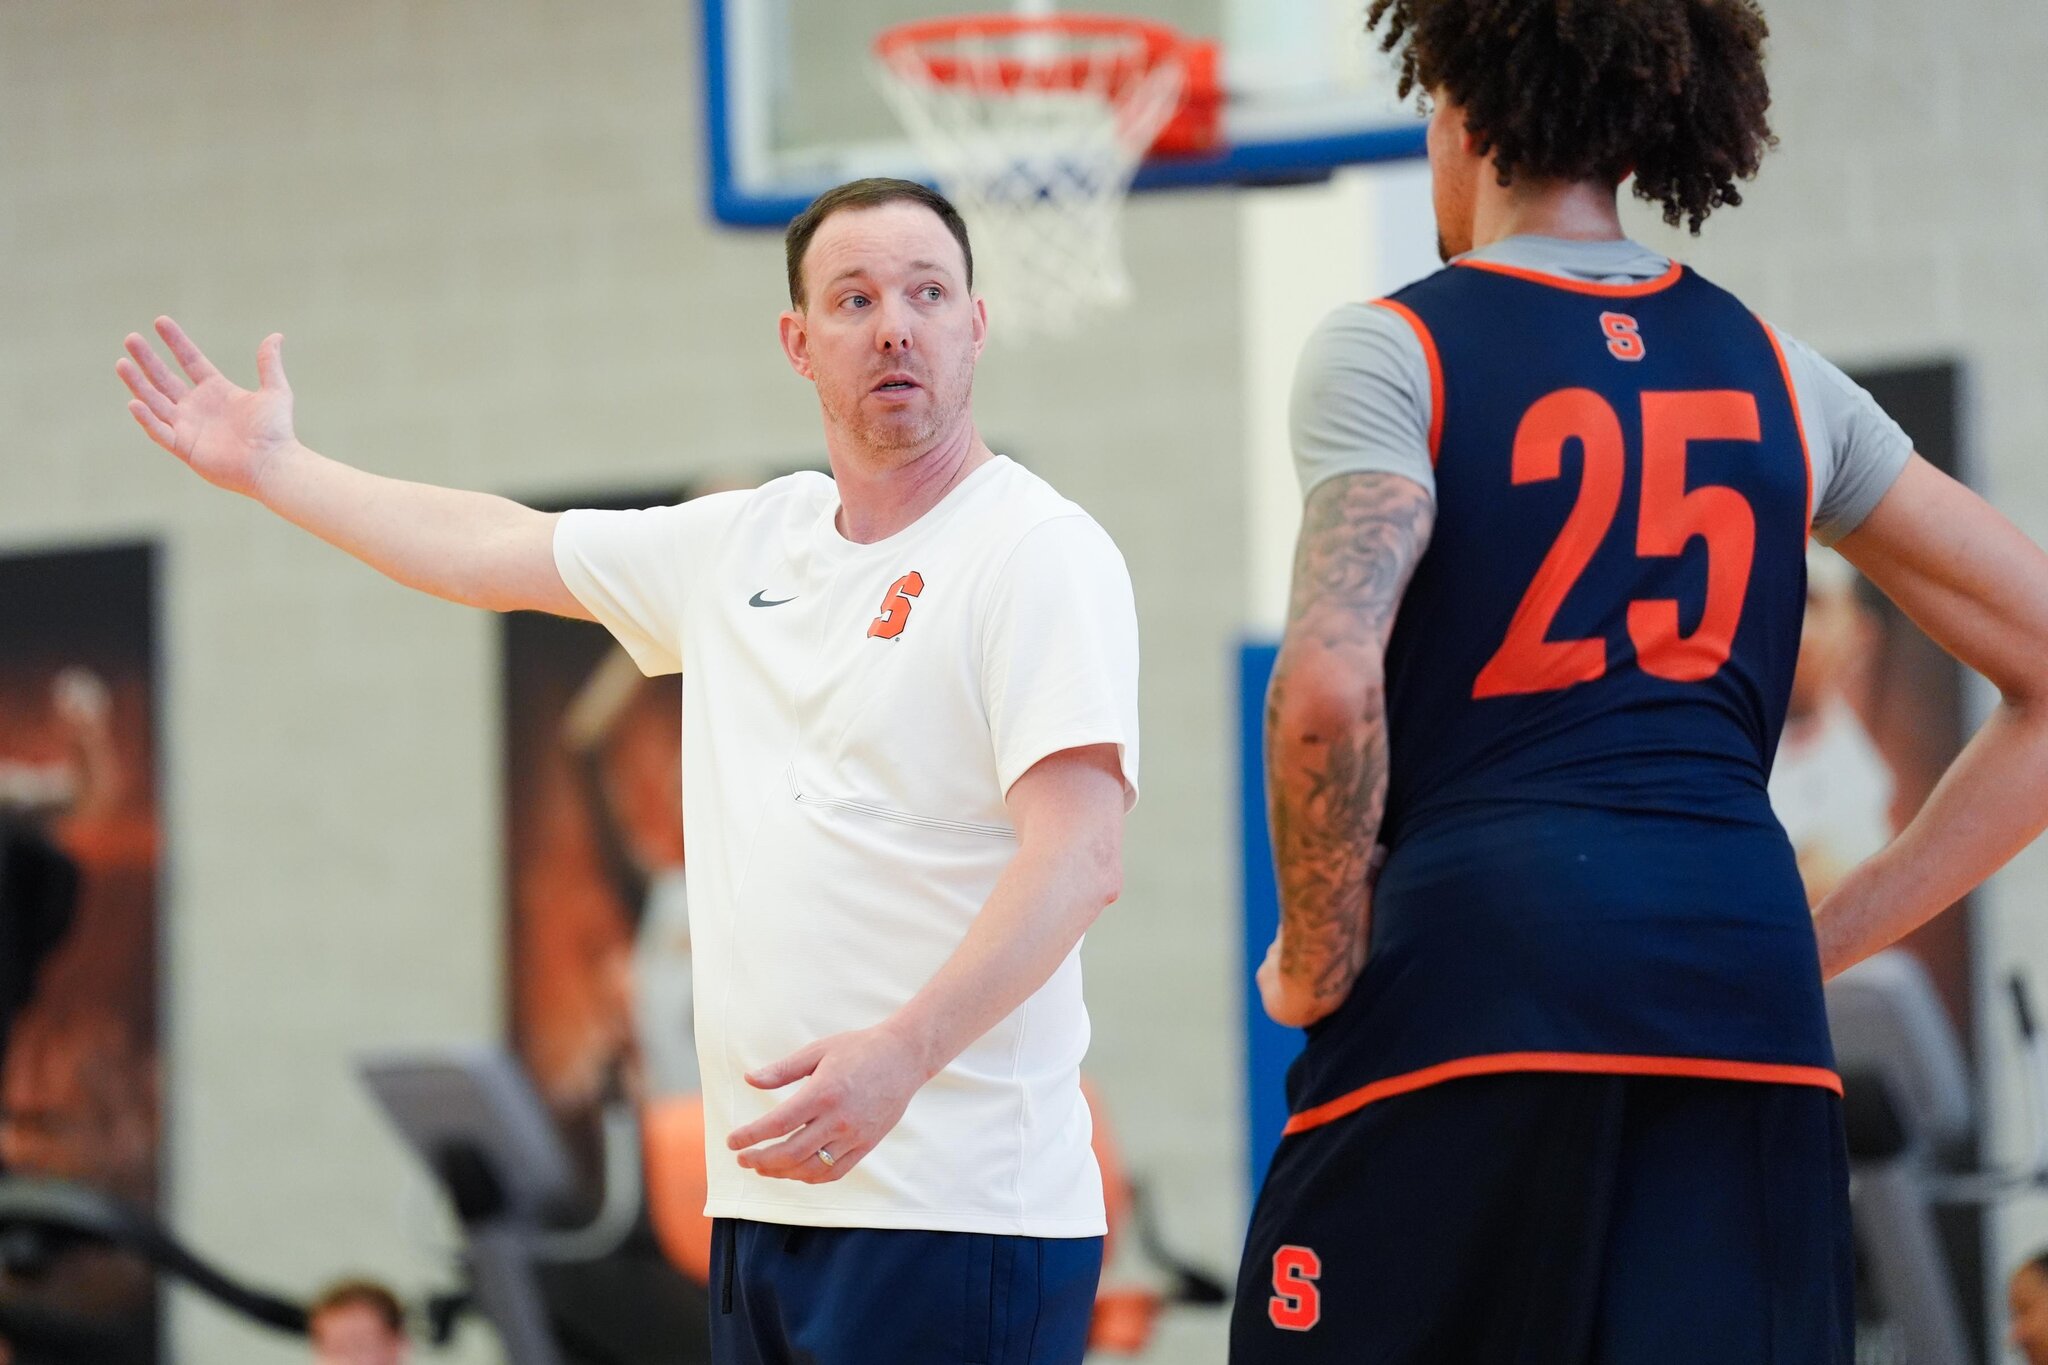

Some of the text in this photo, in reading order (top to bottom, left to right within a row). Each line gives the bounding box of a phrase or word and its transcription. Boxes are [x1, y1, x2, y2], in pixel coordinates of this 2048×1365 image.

[1599, 311, 1647, 362] S
[1472, 387, 1762, 699] 25
[867, 570, 925, 640] S
[1268, 1244, 1322, 1332] S
